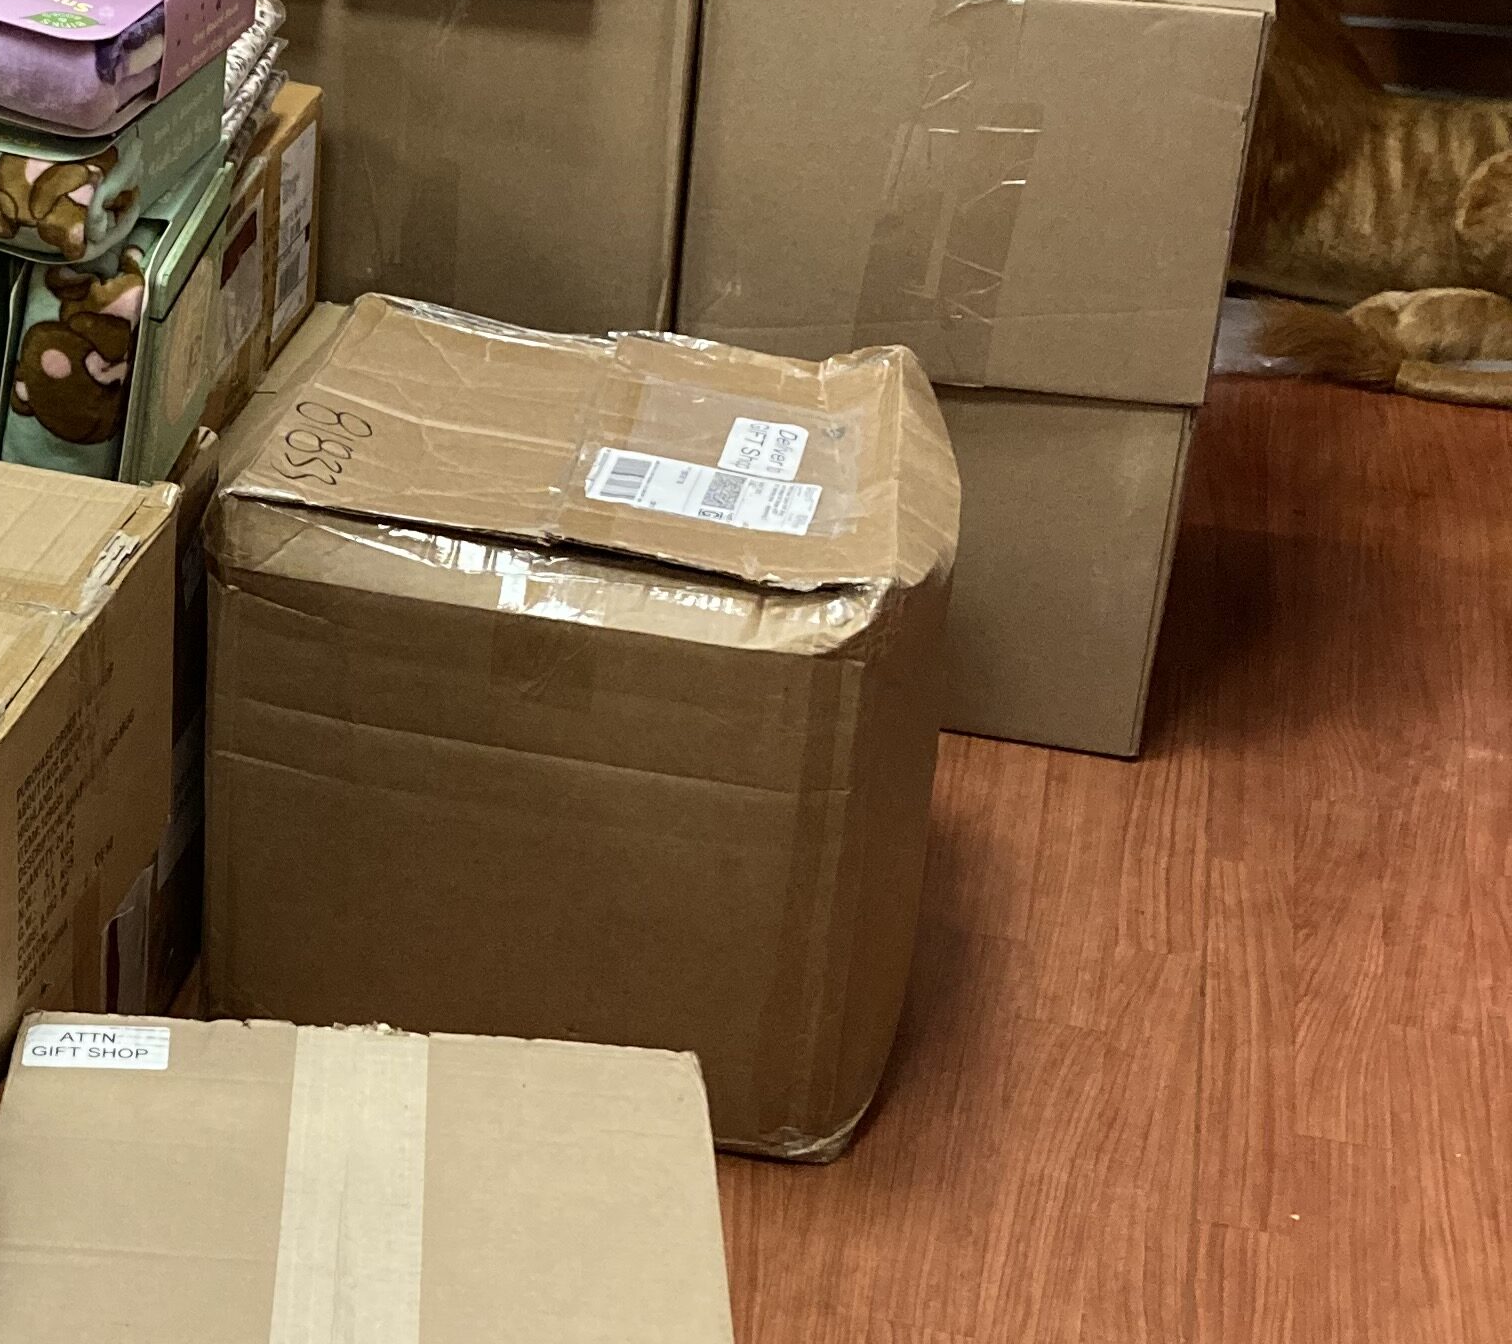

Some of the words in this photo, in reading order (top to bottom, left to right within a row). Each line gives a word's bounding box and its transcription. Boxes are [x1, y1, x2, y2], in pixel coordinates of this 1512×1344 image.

[59, 1030, 118, 1044] ATTN
[31, 1045, 82, 1059] GIFT
[87, 1046, 149, 1060] SHOP
